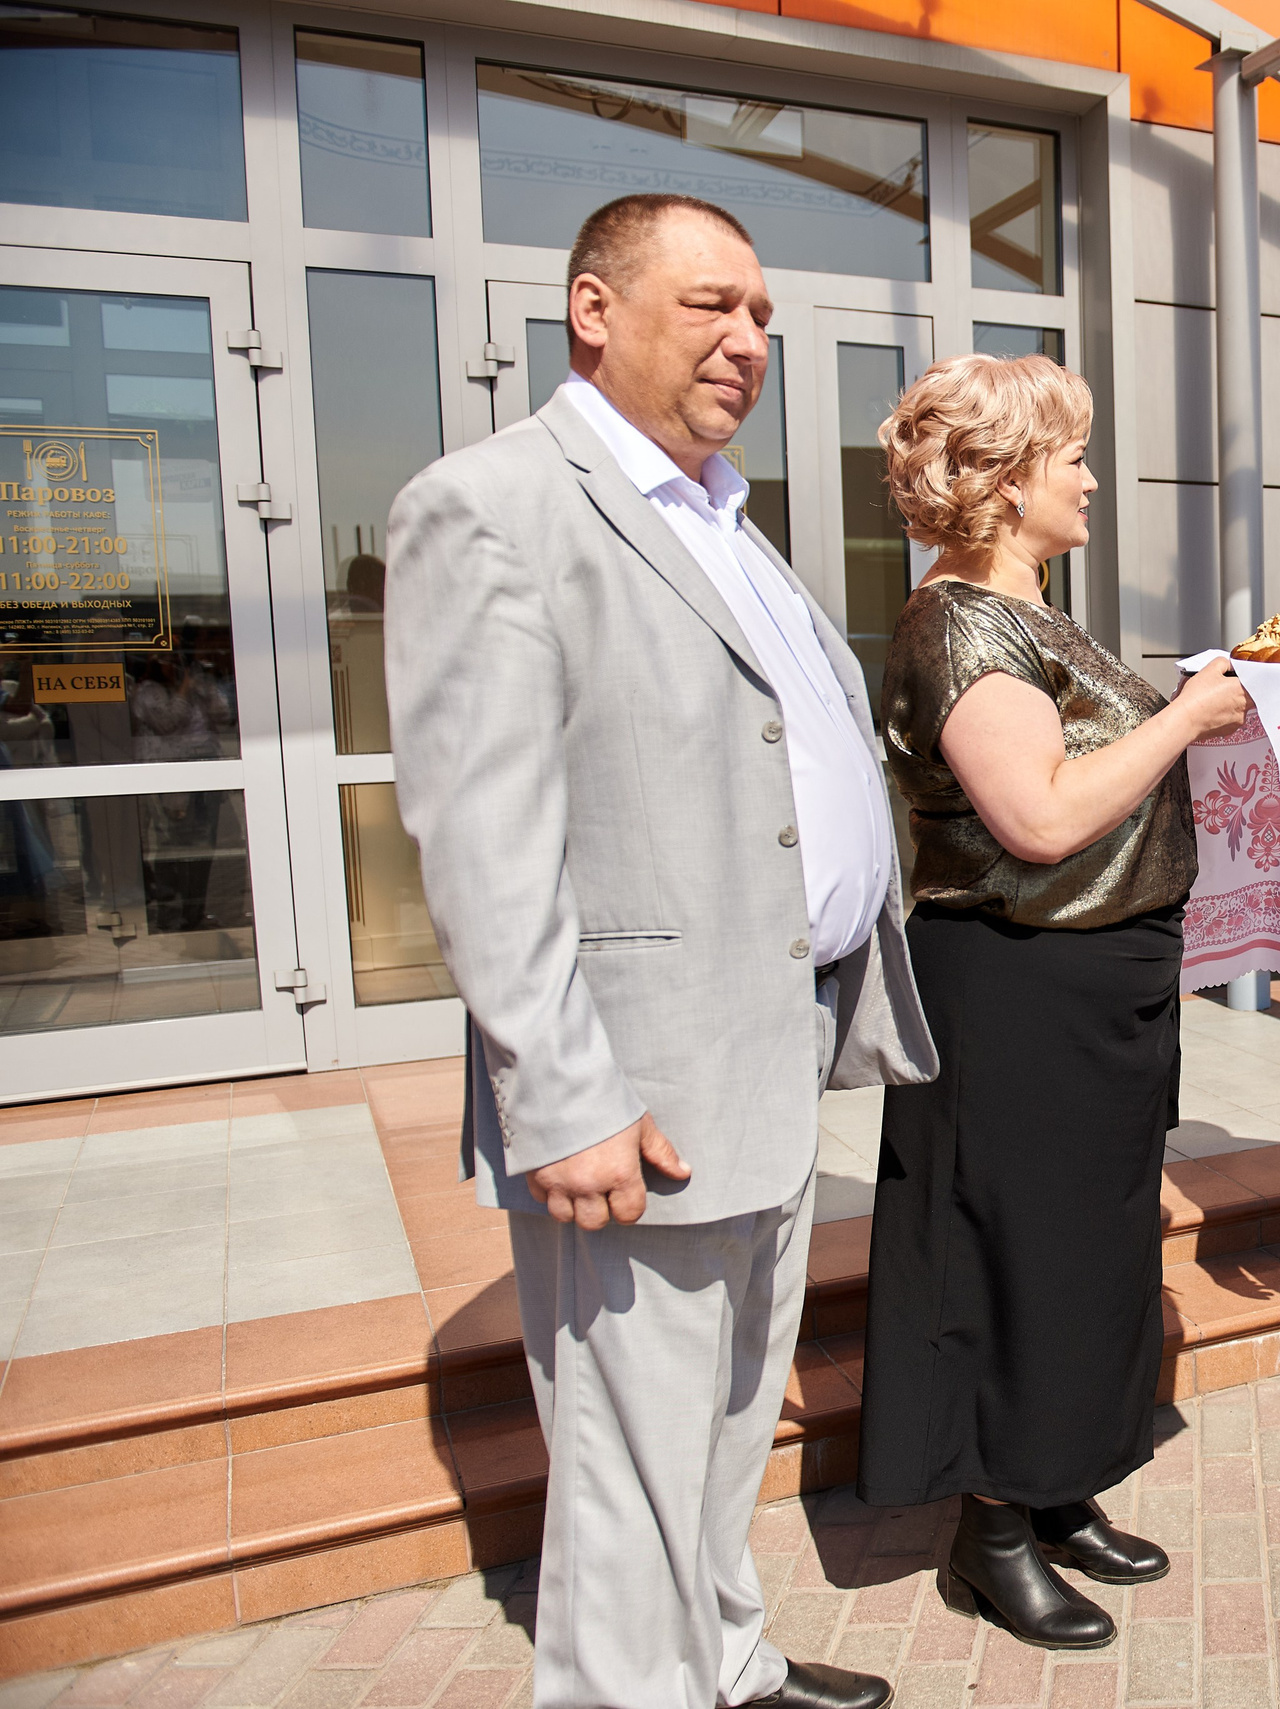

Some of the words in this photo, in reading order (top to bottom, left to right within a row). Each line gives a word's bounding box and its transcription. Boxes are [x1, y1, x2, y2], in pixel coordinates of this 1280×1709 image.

[0, 482, 116, 506] Паровоз
[7, 510, 41, 518] РЕЖИМ
[43, 510, 81, 518] РАБОТЫ
[83, 510, 111, 519] КАФЕ:
[0, 535, 128, 554] 11:00-21:00
[0, 572, 131, 590] 11:00-22:00
[0, 600, 19, 609] БЕЗ
[22, 600, 58, 610] ОБЕДА
[61, 600, 69, 608] И
[71, 600, 132, 610] ВЫХОДНЫХ
[37, 677, 67, 691] НА
[71, 676, 121, 690] СЕБЯ
